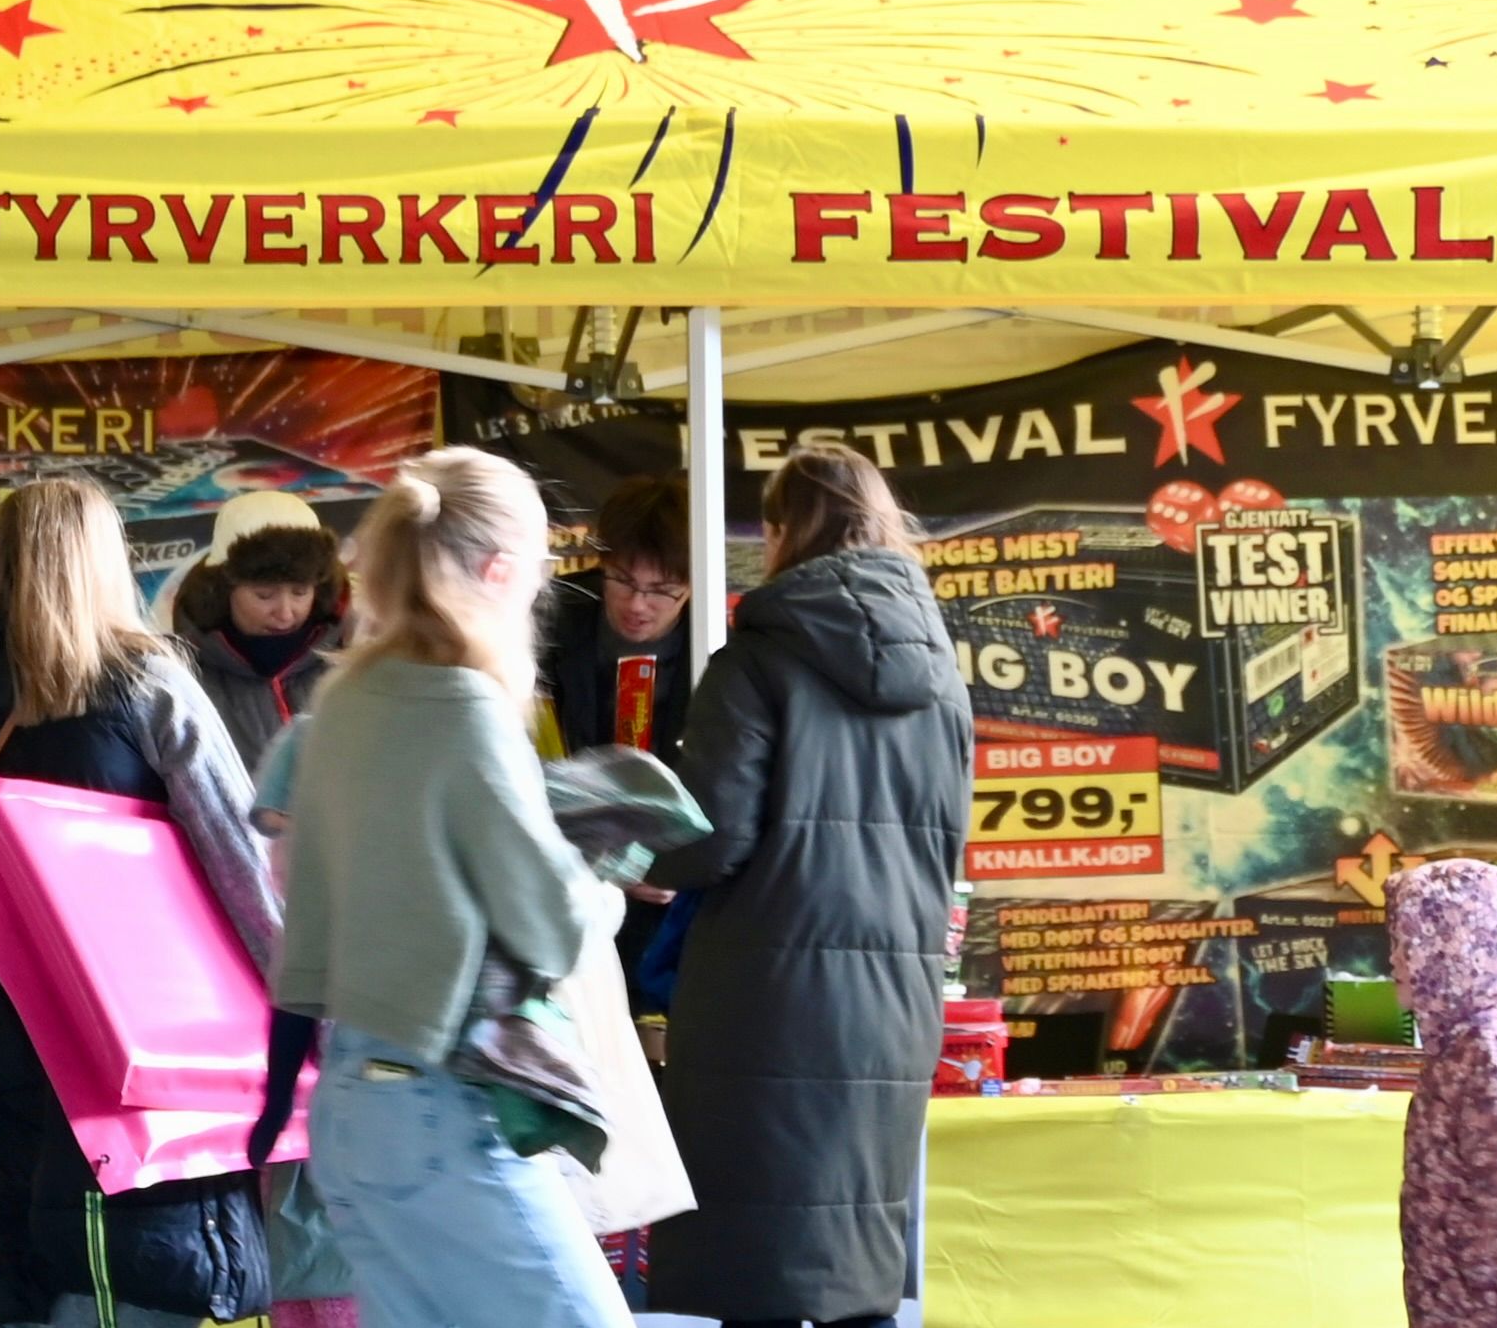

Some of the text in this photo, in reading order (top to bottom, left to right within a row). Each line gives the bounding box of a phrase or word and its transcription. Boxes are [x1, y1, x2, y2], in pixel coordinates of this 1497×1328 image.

[790, 184, 1495, 263] FESTIVAL
[680, 403, 1127, 472] ETIVAL
[1225, 509, 1309, 529] GJENTATT
[128, 541, 195, 566] AKEO
[919, 531, 1082, 568] RGES MEST
[1206, 531, 1329, 587] TEST
[993, 562, 1118, 595] BATTERI
[1209, 587, 1330, 626] VINNER
[1435, 587, 1469, 607] OG
[955, 640, 1198, 713] IG BOY
[986, 745, 1117, 769] BIG BOY
[973, 844, 1153, 871] KNALLKJØP
[997, 902, 1150, 926] PENDELBATTERI
[1000, 930, 1041, 950] MED
[1045, 926, 1096, 948] RØDT
[1099, 925, 1127, 944] OG
[1133, 945, 1187, 965] RØDT
[1003, 976, 1044, 996] MED
[1047, 970, 1162, 992] SPRAKENDE
